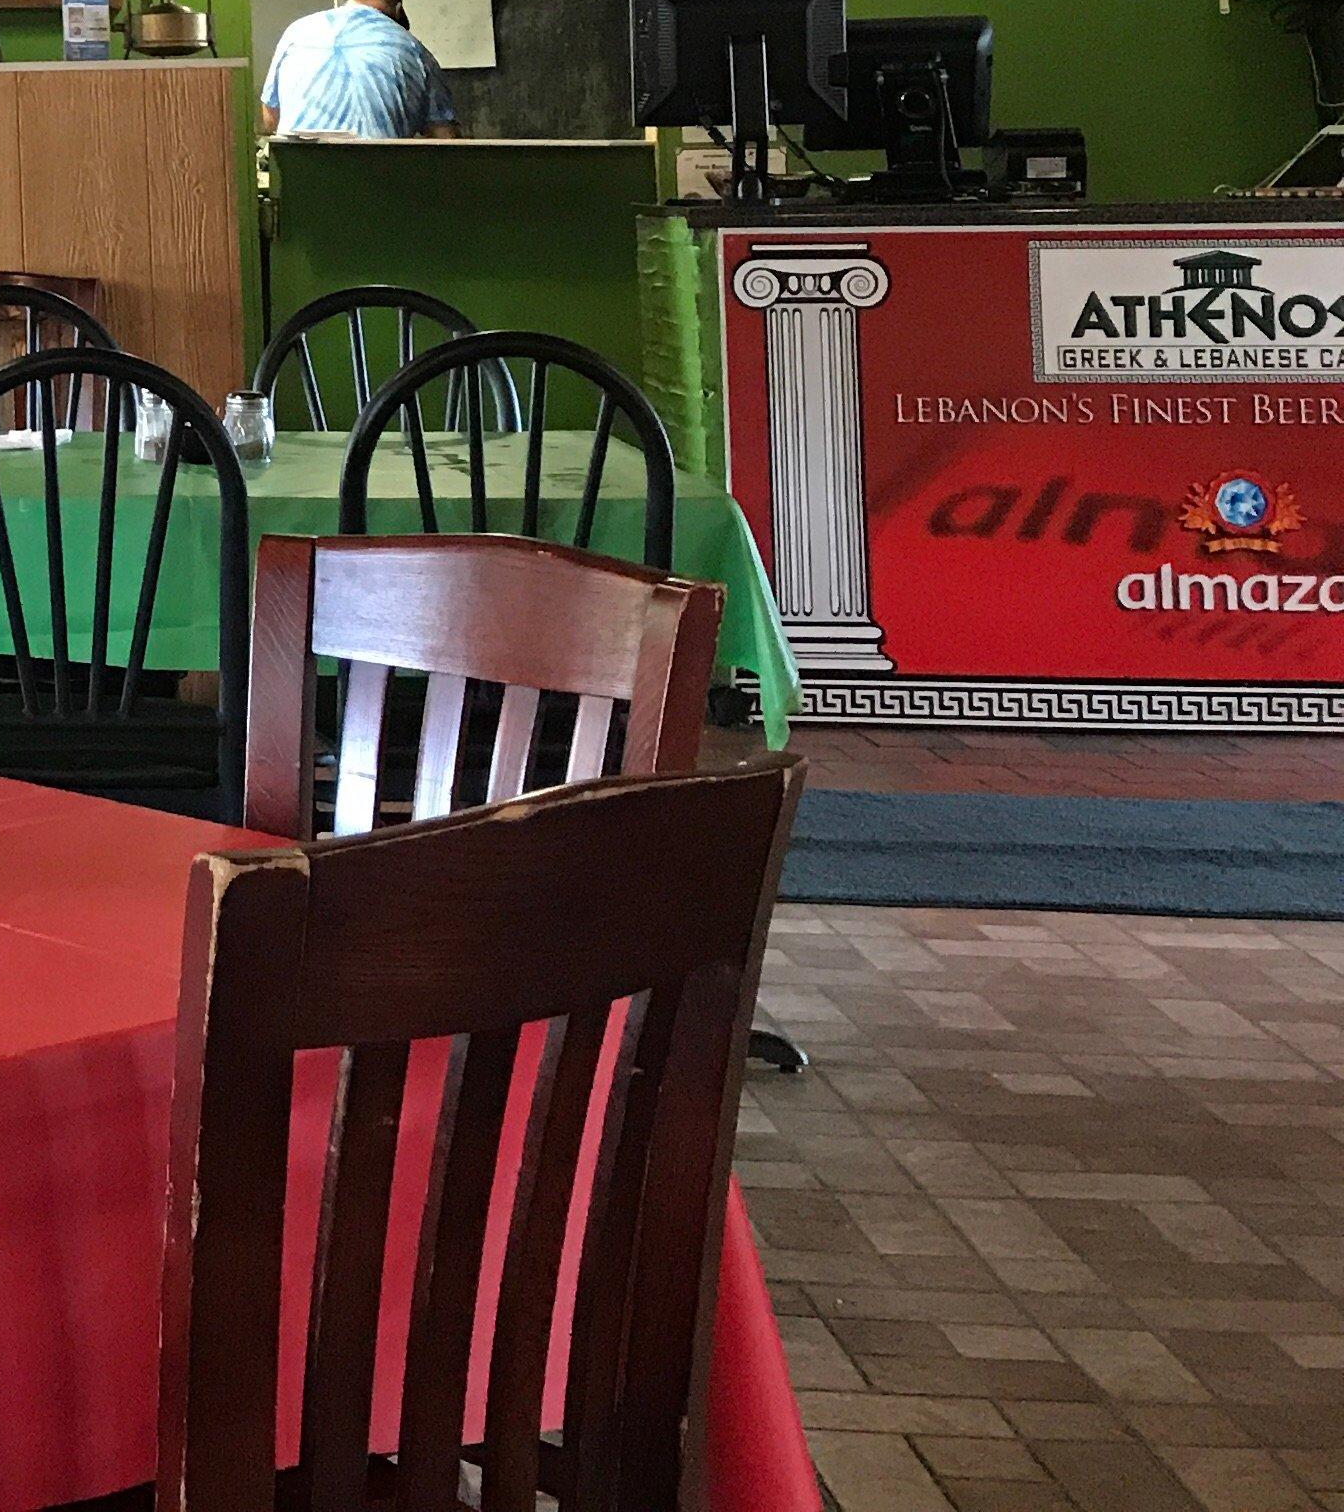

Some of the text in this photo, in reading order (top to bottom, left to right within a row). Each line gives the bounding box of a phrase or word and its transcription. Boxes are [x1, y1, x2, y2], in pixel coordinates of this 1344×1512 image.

[1062, 348, 1145, 369] GREEK
[1153, 348, 1169, 369] &
[1179, 348, 1309, 368] LEBANESE
[895, 392, 1095, 425] LEBANON'S
[1110, 392, 1238, 426] FINEST
